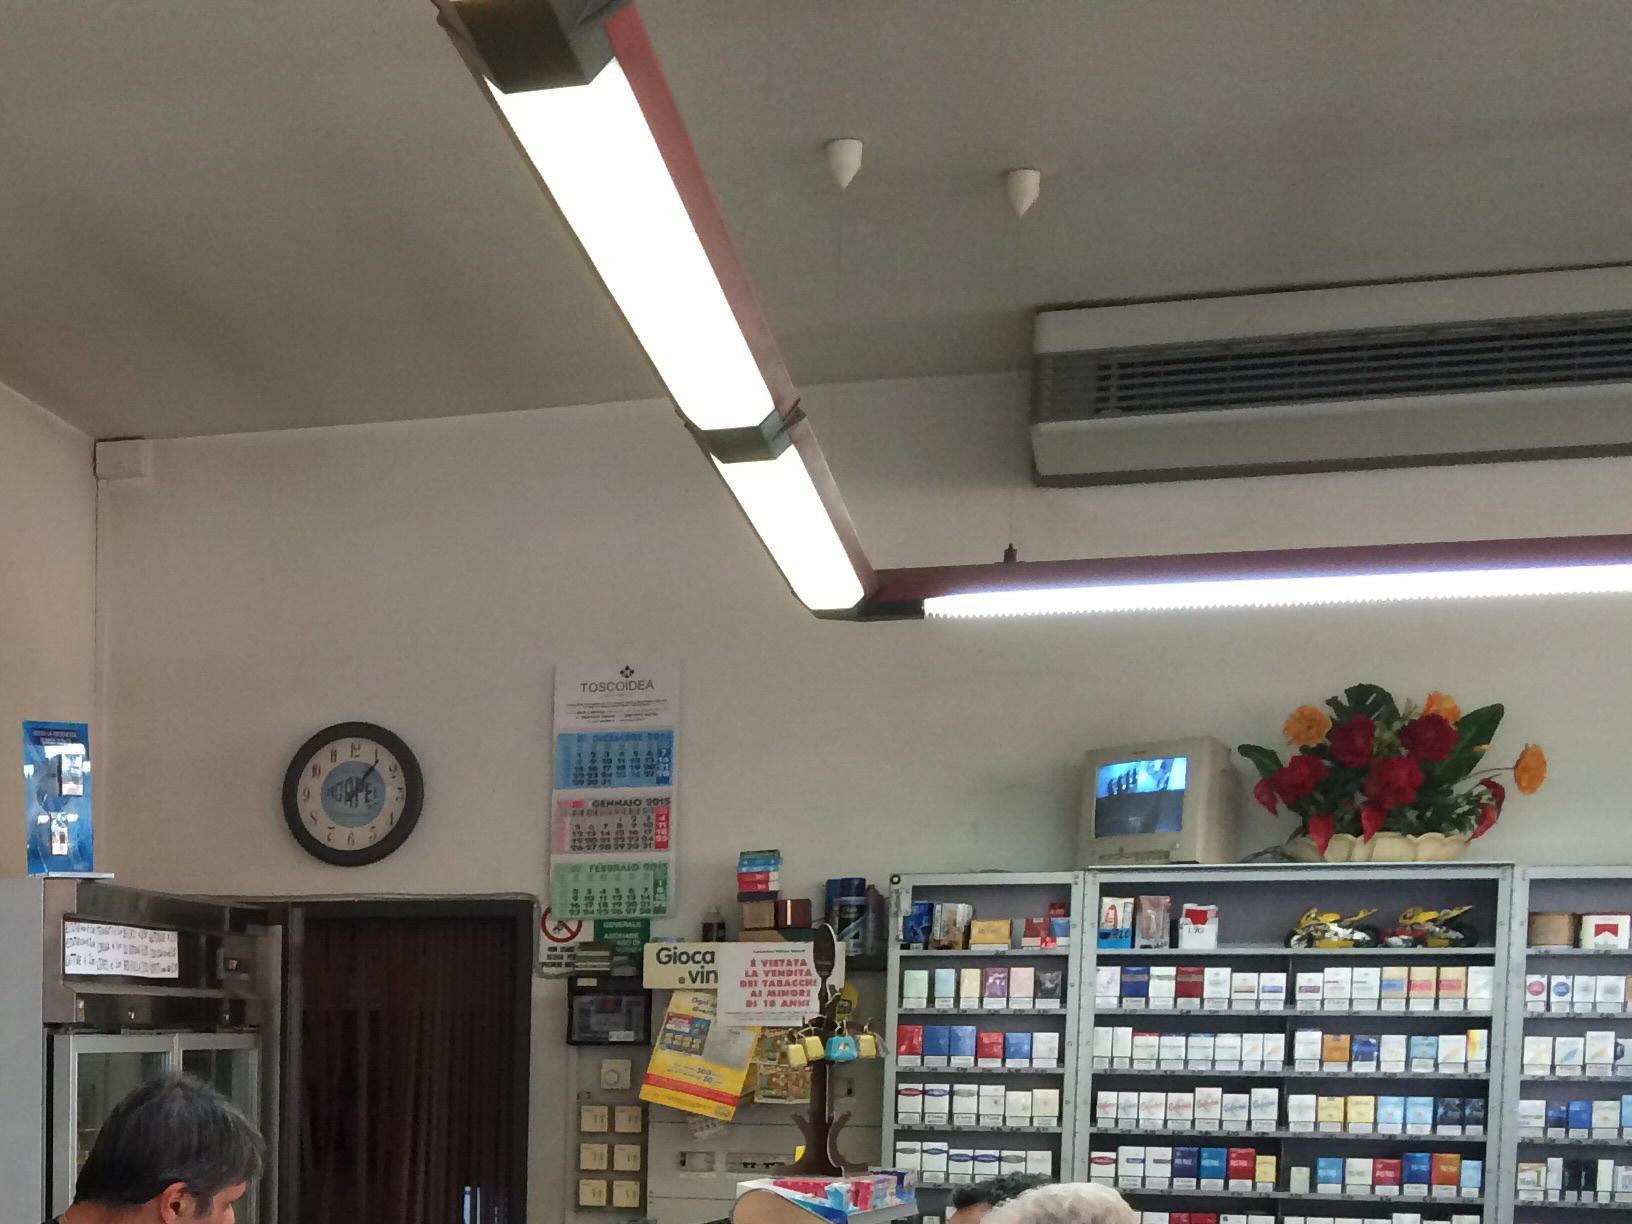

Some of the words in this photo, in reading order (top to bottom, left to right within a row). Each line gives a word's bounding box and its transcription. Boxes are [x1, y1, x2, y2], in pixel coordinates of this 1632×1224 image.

[580, 680, 654, 693] TOSCOIDEA
[592, 798, 642, 808] GENNAIO
[656, 946, 715, 965] Gioca
[761, 958, 808, 967] VIETATA
[745, 969, 758, 978] LA
[764, 968, 812, 977] VENDITA
[762, 979, 817, 987] TABACCHI
[767, 989, 811, 998] MINORI
[781, 1000, 810, 1008] ANNI
